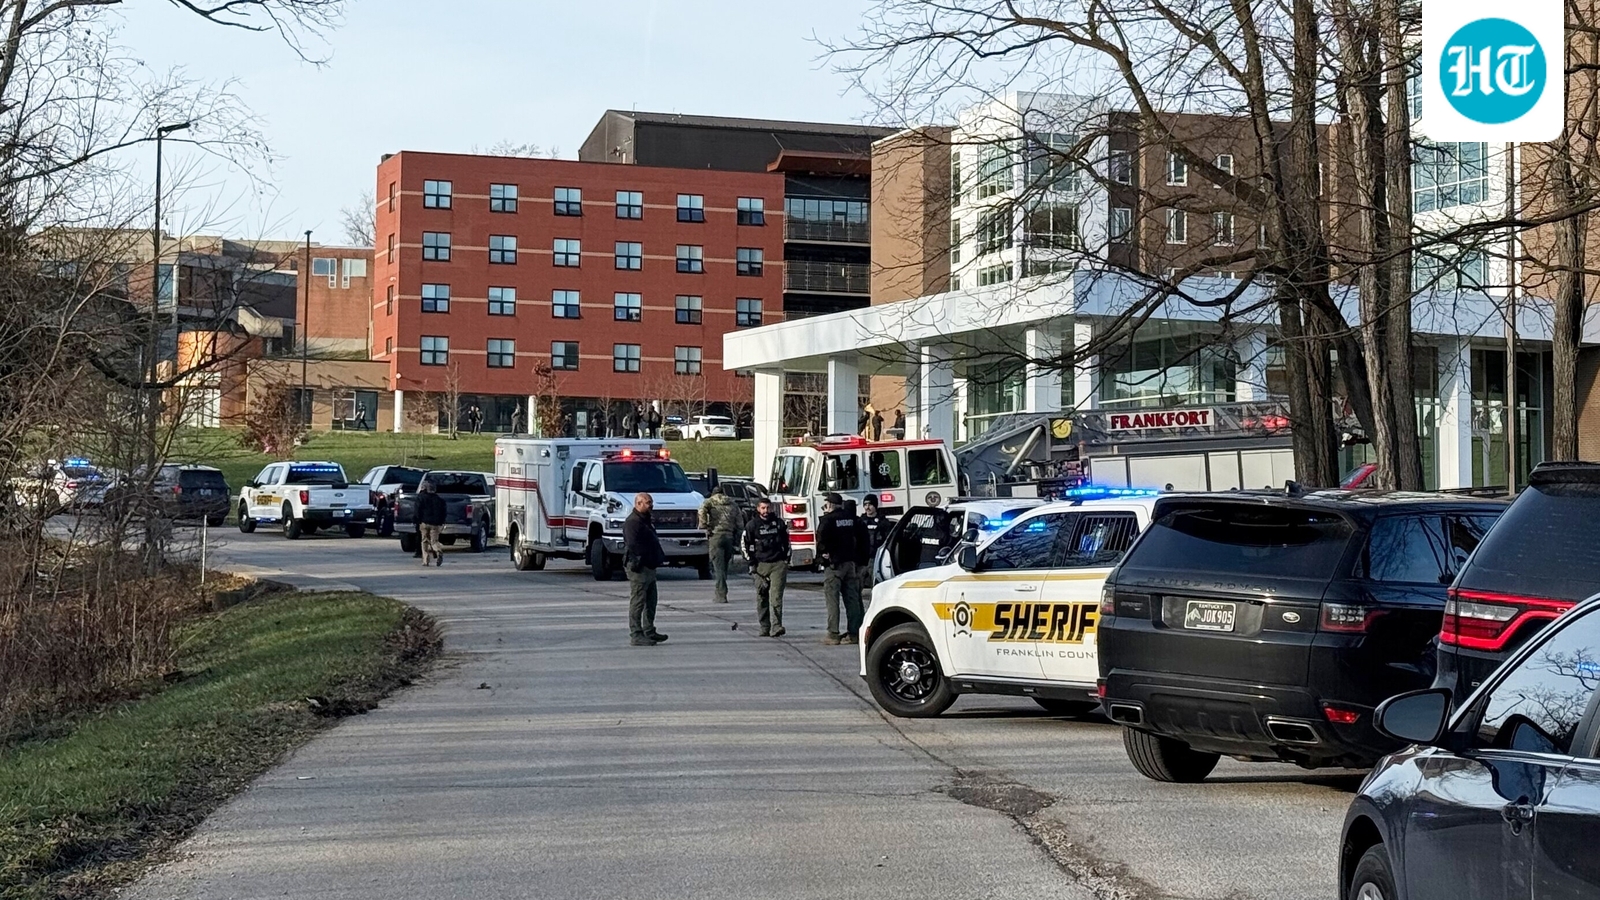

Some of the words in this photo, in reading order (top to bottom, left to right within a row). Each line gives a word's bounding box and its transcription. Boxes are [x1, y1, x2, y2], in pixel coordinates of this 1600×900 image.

[1111, 411, 1209, 429] FRANKFORT
[1147, 577, 1202, 587] RANGE
[1214, 582, 1277, 592] ROVER
[988, 602, 1099, 643] SHERIF
[996, 648, 1054, 658] FRANKLIN
[1058, 650, 1099, 659] COUN
